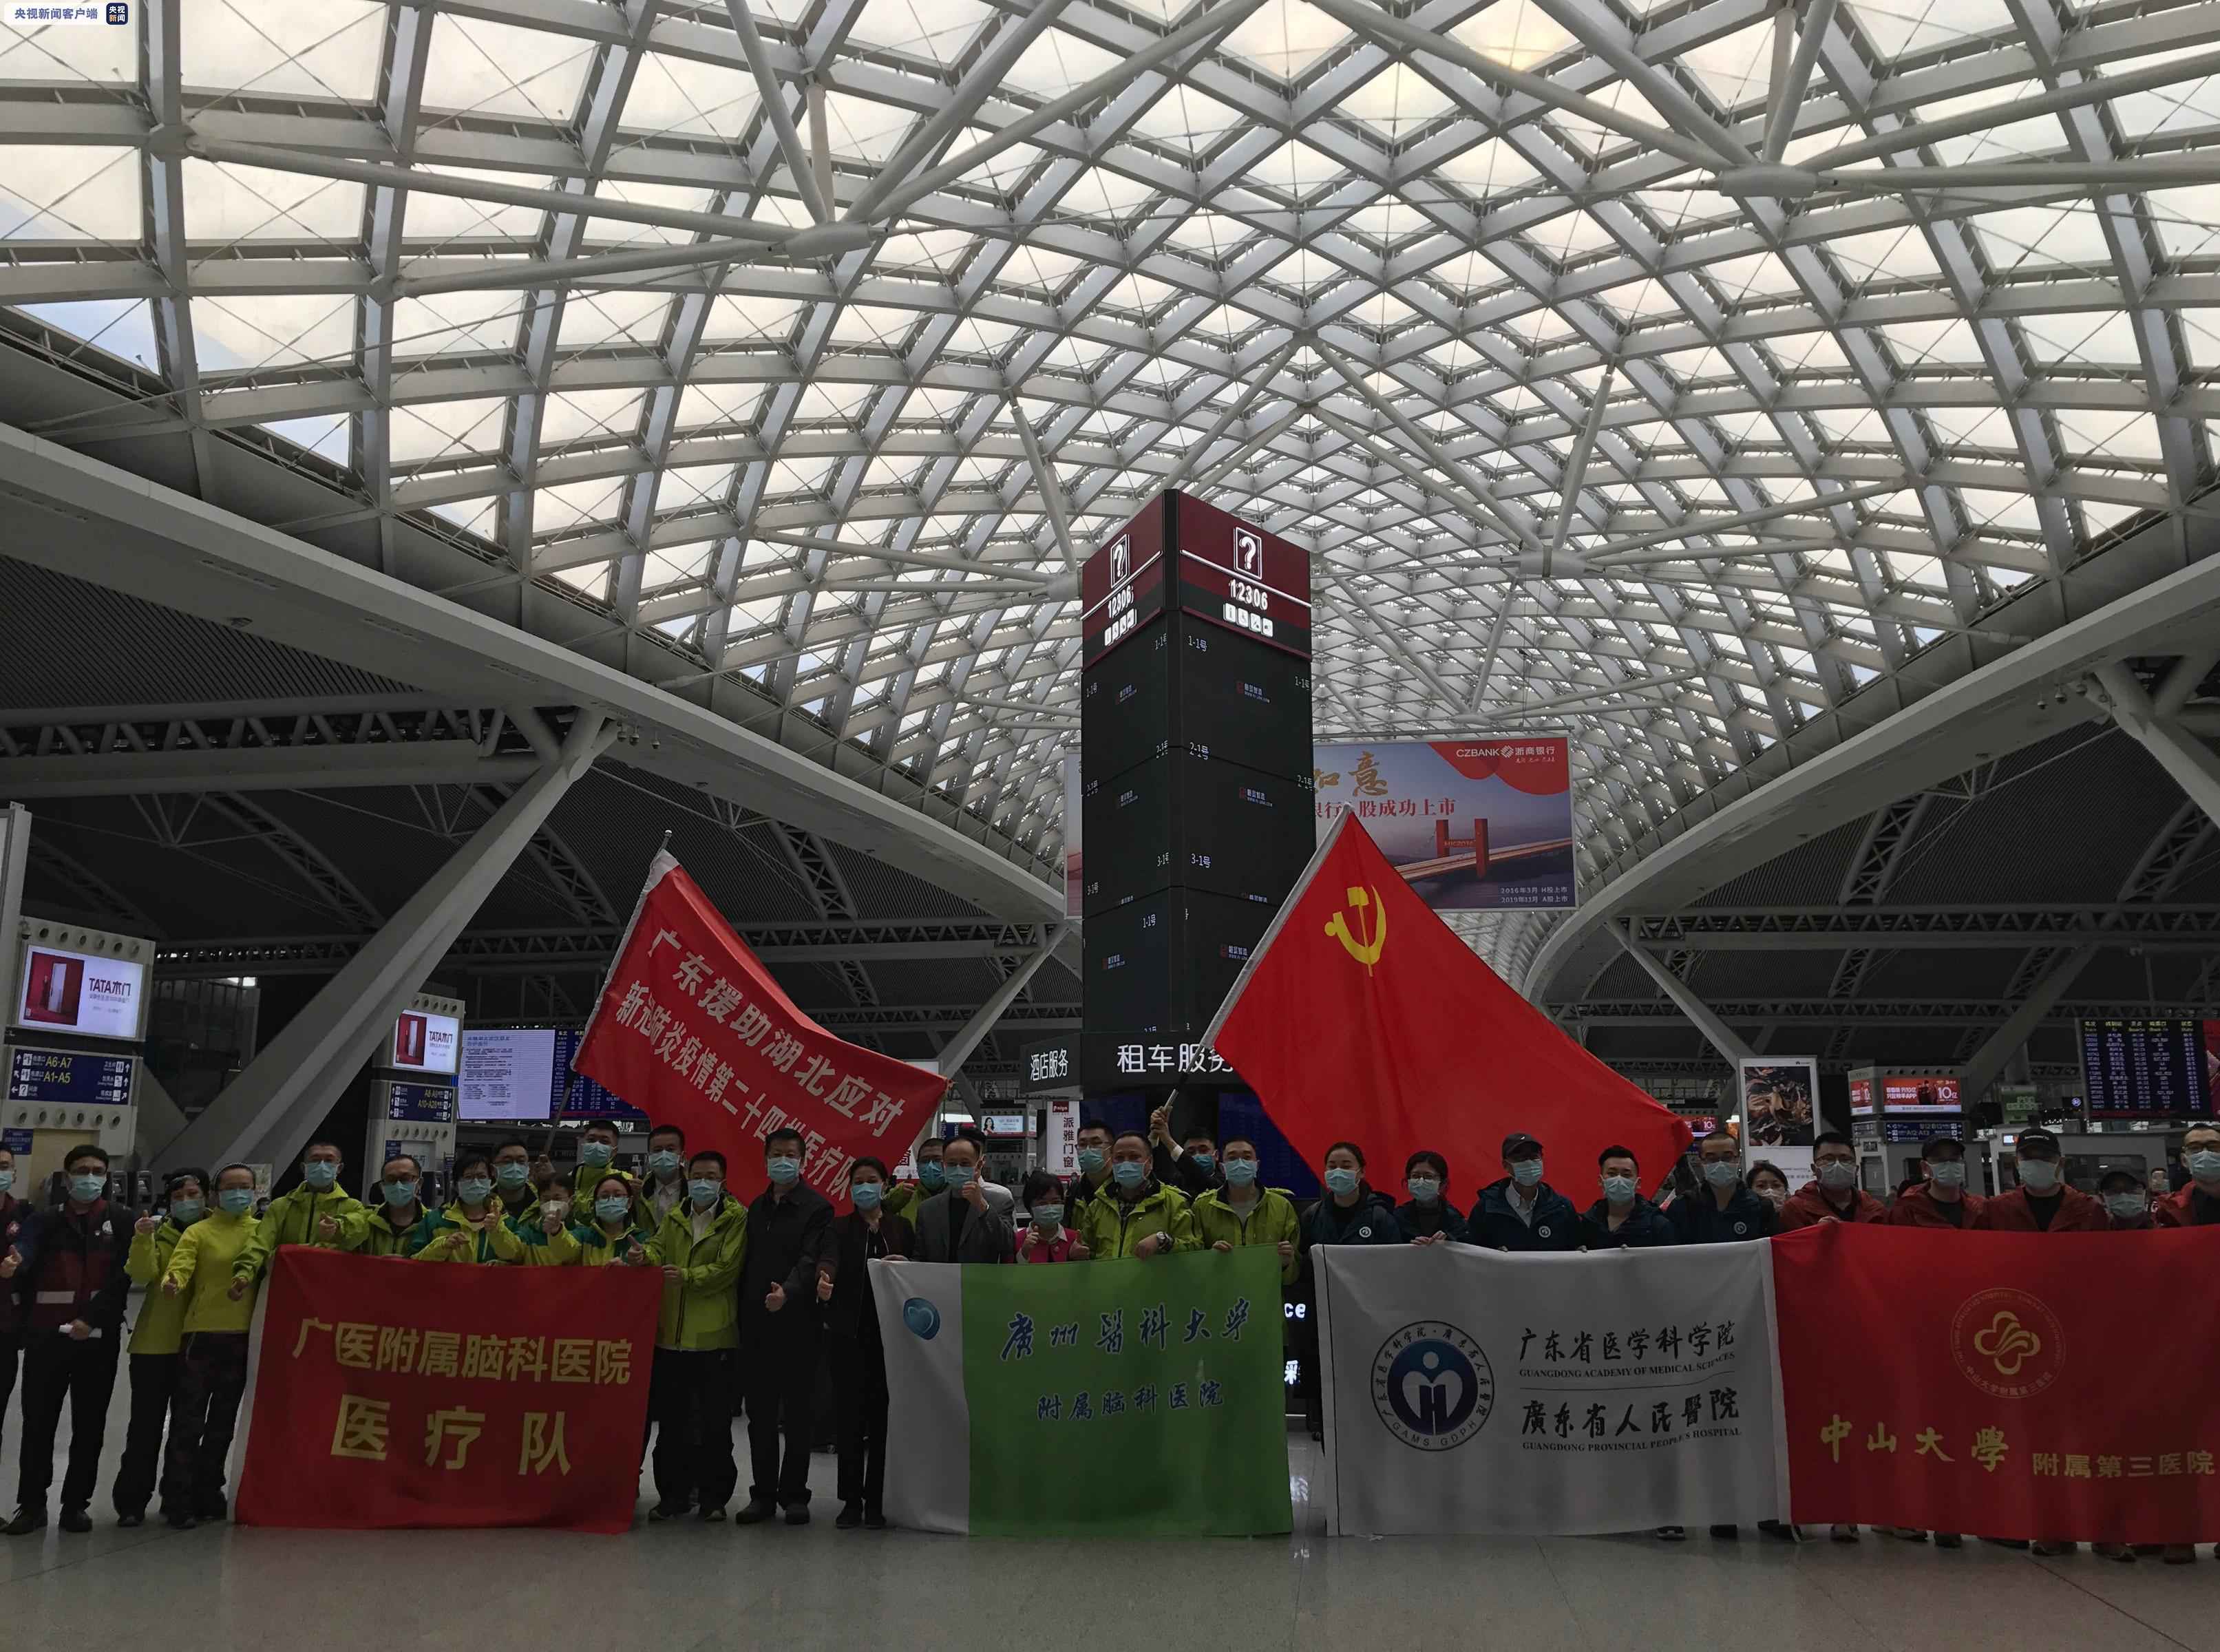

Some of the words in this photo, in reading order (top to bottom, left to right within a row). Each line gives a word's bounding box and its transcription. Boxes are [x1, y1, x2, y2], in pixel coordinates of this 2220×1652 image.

[1108, 585, 1134, 618] 12306
[1229, 579, 1268, 610] 12306
[1456, 748, 1500, 757] CZBANK
[1515, 746, 1555, 756] 浙商银行
[1315, 798, 1457, 818] 行股成功上市
[1191, 854, 1211, 868] 3-1号
[89, 977, 131, 997] TATA木门
[646, 927, 906, 1138] 广东援助湖北应对
[43, 1071, 72, 1084] A1-A5
[1030, 1048, 1068, 1081] 酒店服务
[1063, 1116, 1075, 1168] 派雅门窗
[292, 1316, 633, 1385] 广医附属脑科医院
[1519, 1320, 1735, 1364] 广东省医学科学院
[1519, 1368, 1582, 1377] GUANGDONG
[1585, 1367, 1632, 1377] ACADEMY
[1634, 1366, 1647, 1375] OF
[1649, 1364, 1693, 1375] MEDICAL
[1037, 1380, 1225, 1421] 附属脑科医院
[330, 1393, 572, 1476] 医疗队
[1392, 1421, 1430, 1446] GAMS
[1440, 1420, 1477, 1446] GDPH
[1523, 1441, 1585, 1452] GUANGDONG
[1588, 1441, 1648, 1452] PROVINCIAL
[1693, 1426, 1741, 1439] HOSPITAL
[1820, 1414, 2009, 1472] 中山大學
[2032, 1448, 2216, 1479] 附属第三医院
